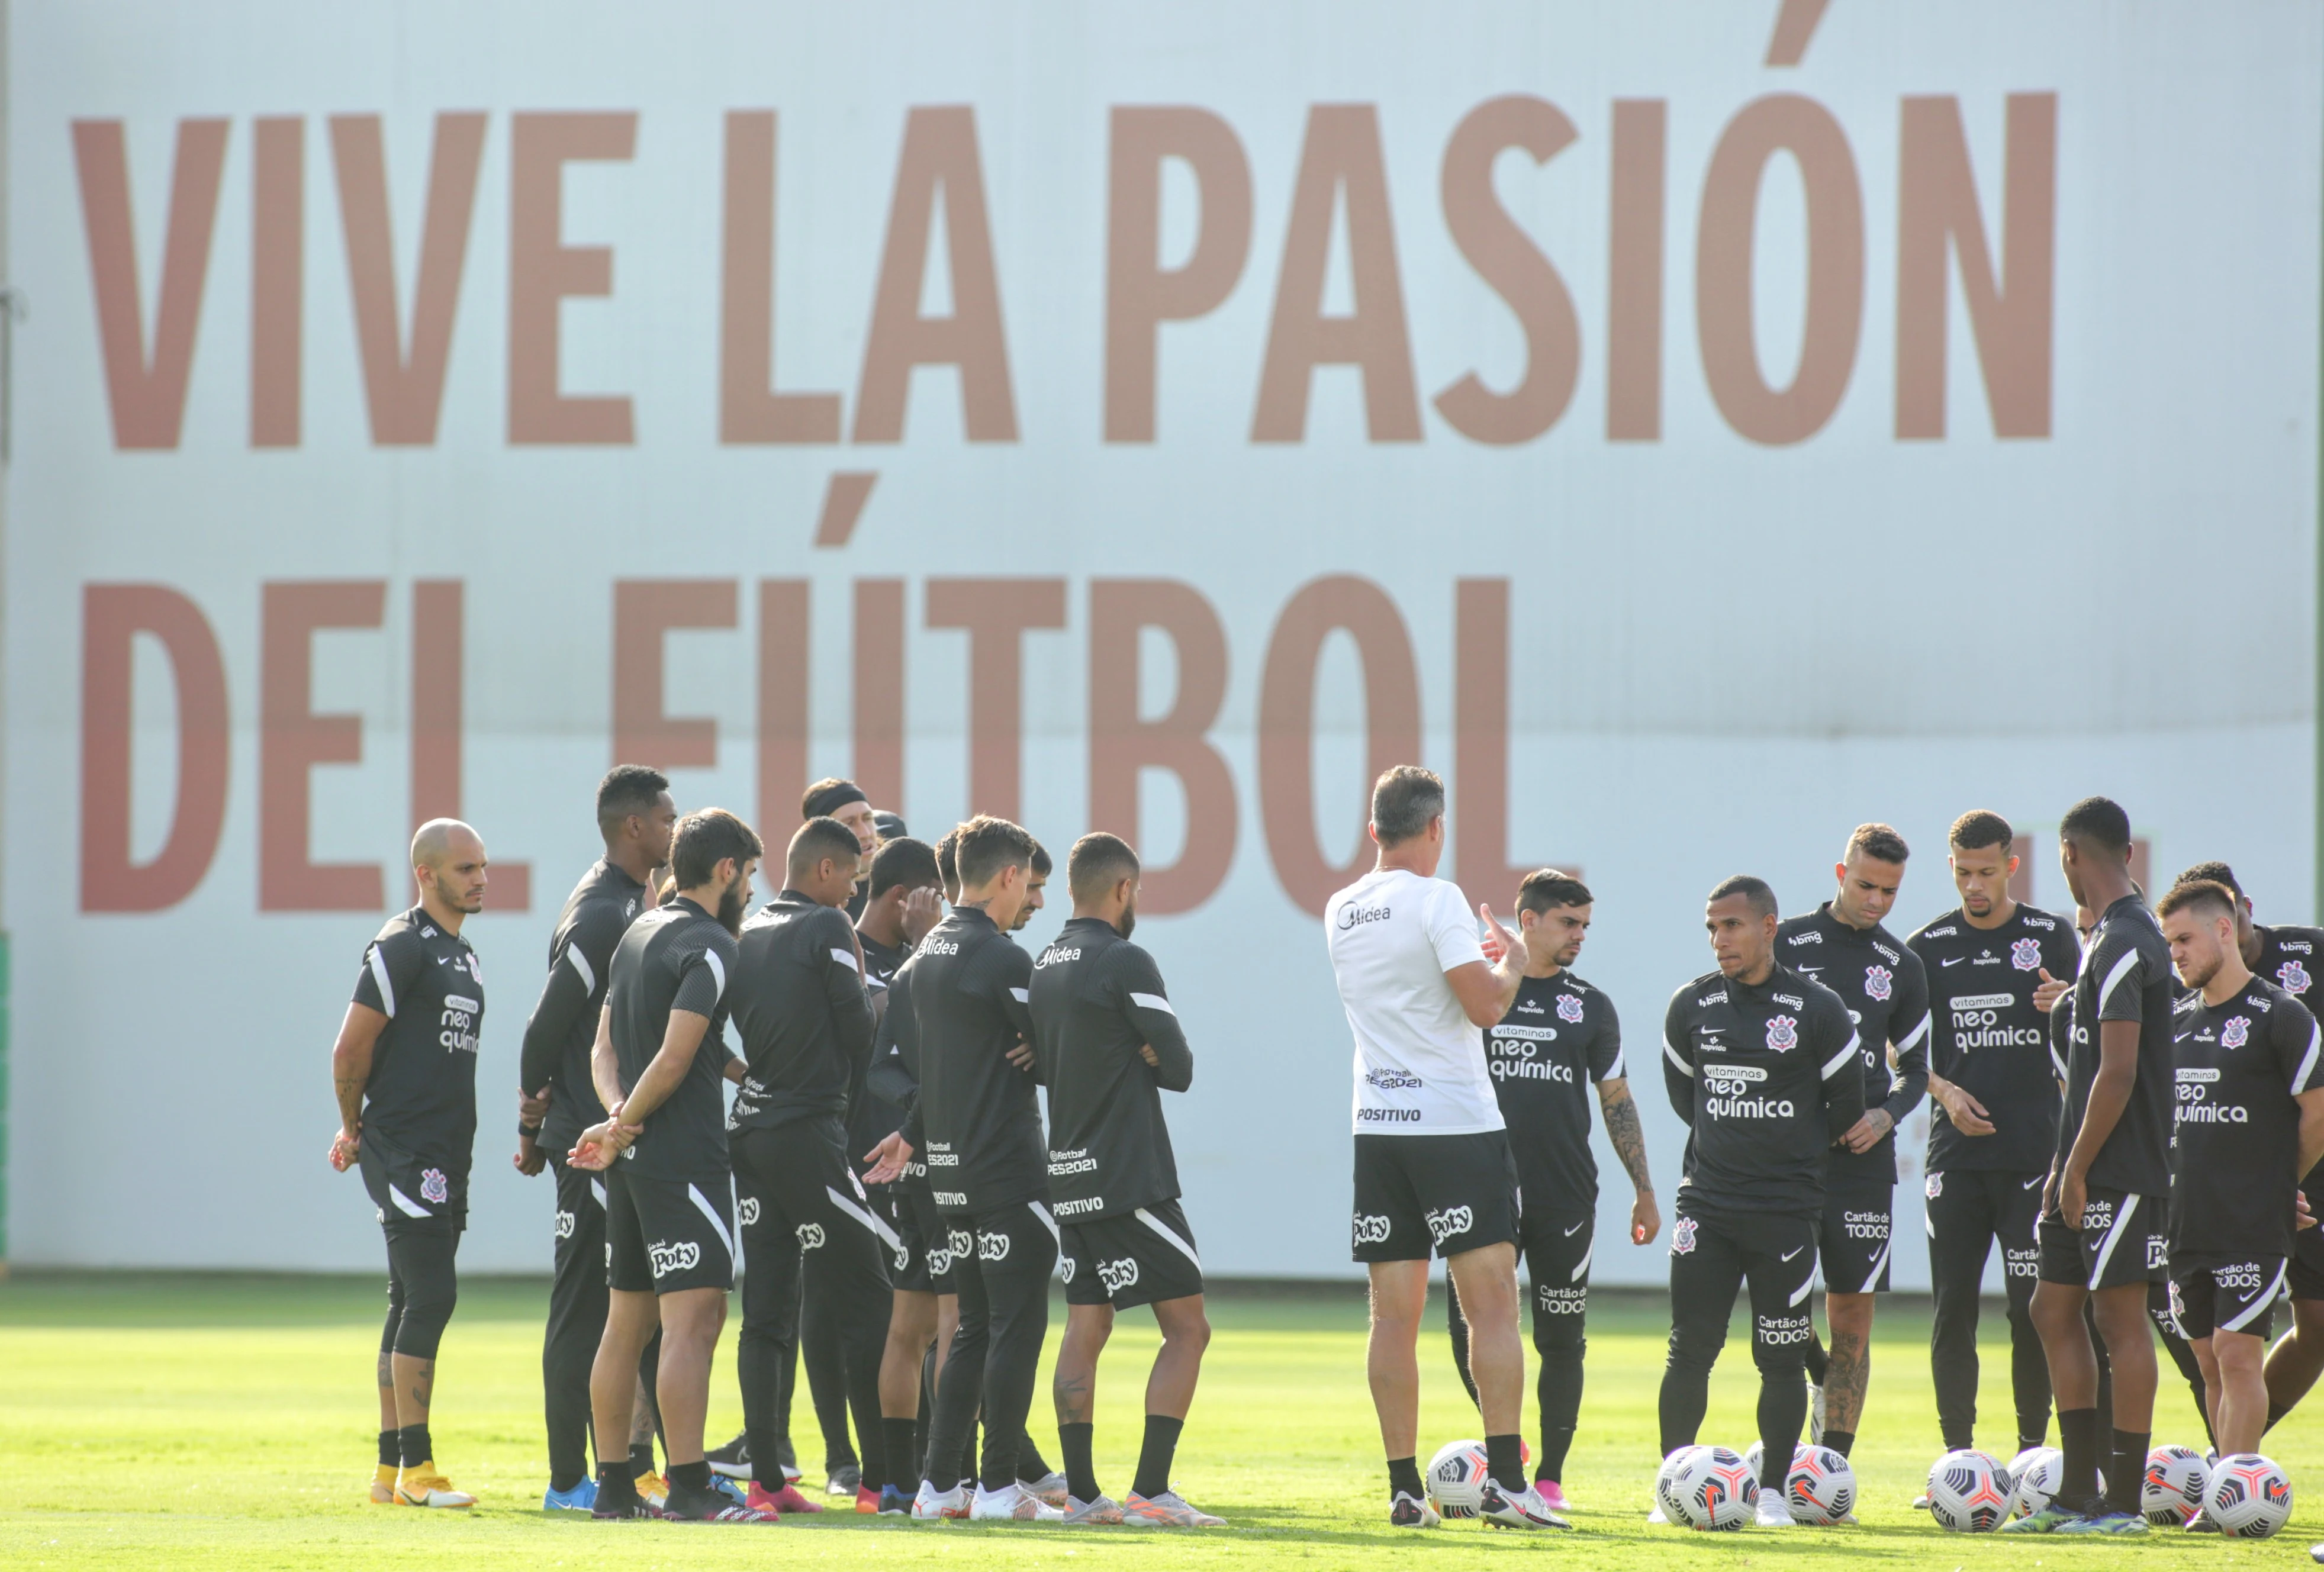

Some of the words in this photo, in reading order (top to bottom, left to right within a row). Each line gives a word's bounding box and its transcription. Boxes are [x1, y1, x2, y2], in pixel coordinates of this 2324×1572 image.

[70, 110, 639, 453] VIVE
[719, 104, 1019, 446] LA
[1102, 0, 2058, 447] PASIÓN
[79, 578, 532, 916] DEL
[612, 472, 1593, 921] FÚTBOL
[1340, 903, 1390, 929] Midea
[1932, 927, 1957, 937] bmg
[2031, 918, 2055, 931] bmg
[1796, 932, 1823, 945] bmg
[918, 936, 959, 958] Midea
[1878, 944, 1900, 966] bmg
[2287, 942, 2312, 955] bmg
[1035, 944, 1081, 968] Midea
[1973, 957, 2001, 966] hapvida
[1705, 991, 1728, 1006] bmg
[1778, 994, 1804, 1011] bmg
[1954, 996, 2009, 1007] vitaminas
[2252, 997, 2271, 1013] bmg
[1517, 1006, 1544, 1014] hapvida
[441, 1010, 470, 1029] neo
[1953, 1010, 1997, 1028] neo
[1496, 1027, 1552, 1038] vitaminas
[1955, 1025, 2041, 1054] química
[1491, 1039, 1537, 1058] neo
[1700, 1043, 1727, 1052] hapvida
[1490, 1057, 1572, 1084] química
[1707, 1067, 1762, 1078] vitaminas
[1704, 1078, 1747, 1096] neo
[1357, 1108, 1421, 1122] POSITIVO
[1706, 1095, 1794, 1121] química
[927, 1154, 959, 1166] ES2021
[1047, 1158, 1097, 1175] PES2021
[933, 1191, 968, 1205] OSITIVO
[1052, 1196, 1104, 1216] POSITIVO
[2097, 1200, 2111, 1212] de
[1430, 1209, 1469, 1242] Poty
[1845, 1212, 1880, 1223] Cartão
[1881, 1212, 1890, 1223] de
[2084, 1213, 2112, 1229] DOS
[1845, 1224, 1889, 1239] TODOS
[978, 1237, 1007, 1257] oty
[653, 1245, 697, 1275] Poty
[2245, 1262, 2260, 1273] de
[2007, 1262, 2039, 1277] TOD
[1540, 1284, 1579, 1299] Cartão
[1540, 1297, 1585, 1314] TODOS
[1759, 1315, 1797, 1328] Cartão
[1759, 1327, 1810, 1345] TODOS
